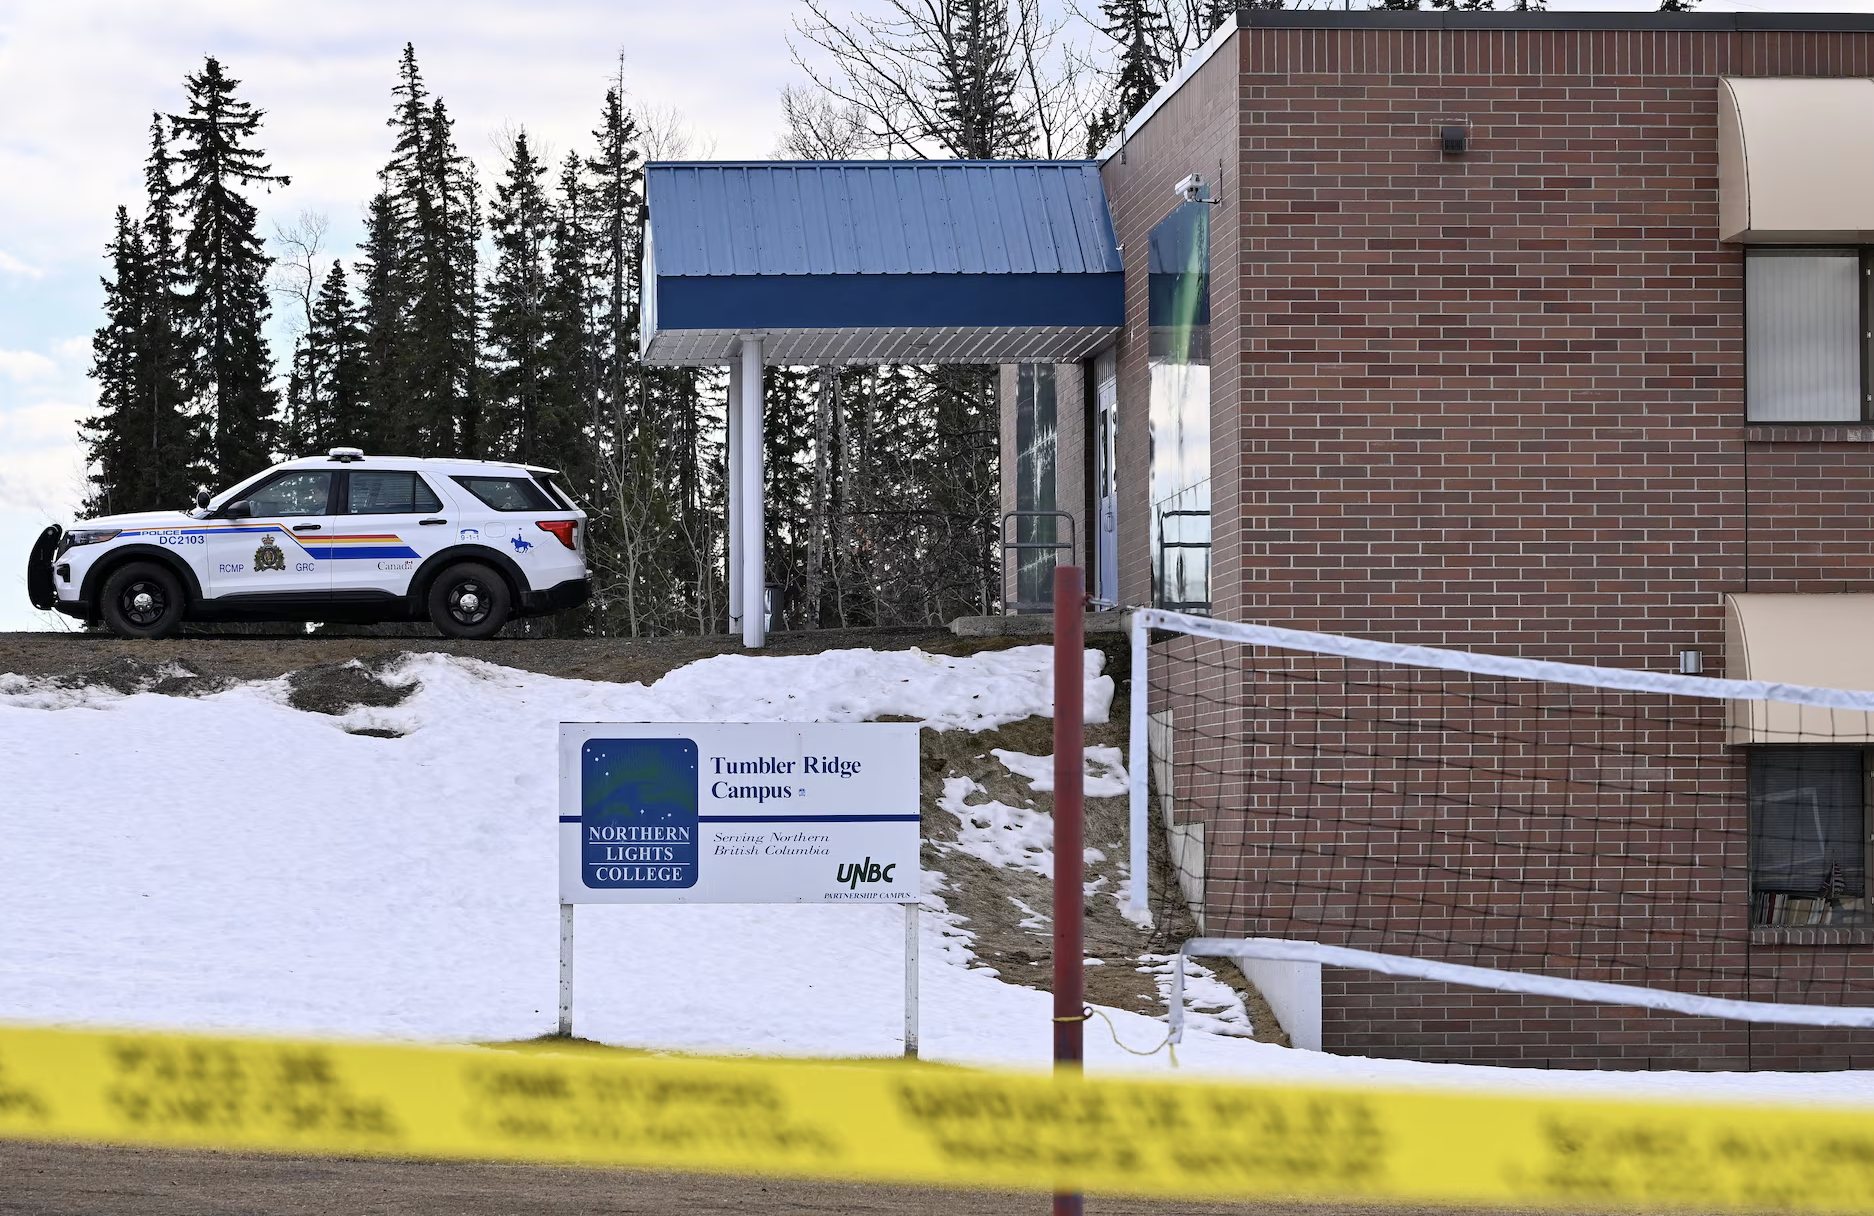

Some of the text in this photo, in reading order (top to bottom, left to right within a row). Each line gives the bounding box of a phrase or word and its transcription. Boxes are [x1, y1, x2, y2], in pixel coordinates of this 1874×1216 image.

[160, 535, 204, 545] DC2103
[220, 564, 244, 572] RCMP
[296, 563, 314, 571] GRC
[377, 561, 413, 570] Canada
[711, 756, 861, 778] Tumbler Ridge
[711, 781, 792, 803] Campus
[589, 826, 690, 841] NORTHERN
[713, 832, 830, 844] Serving Northern
[606, 846, 674, 861] LIGHTS
[713, 845, 830, 856] British Columbia
[596, 866, 683, 881] COLLEGE
[836, 856, 896, 890] UNBC
